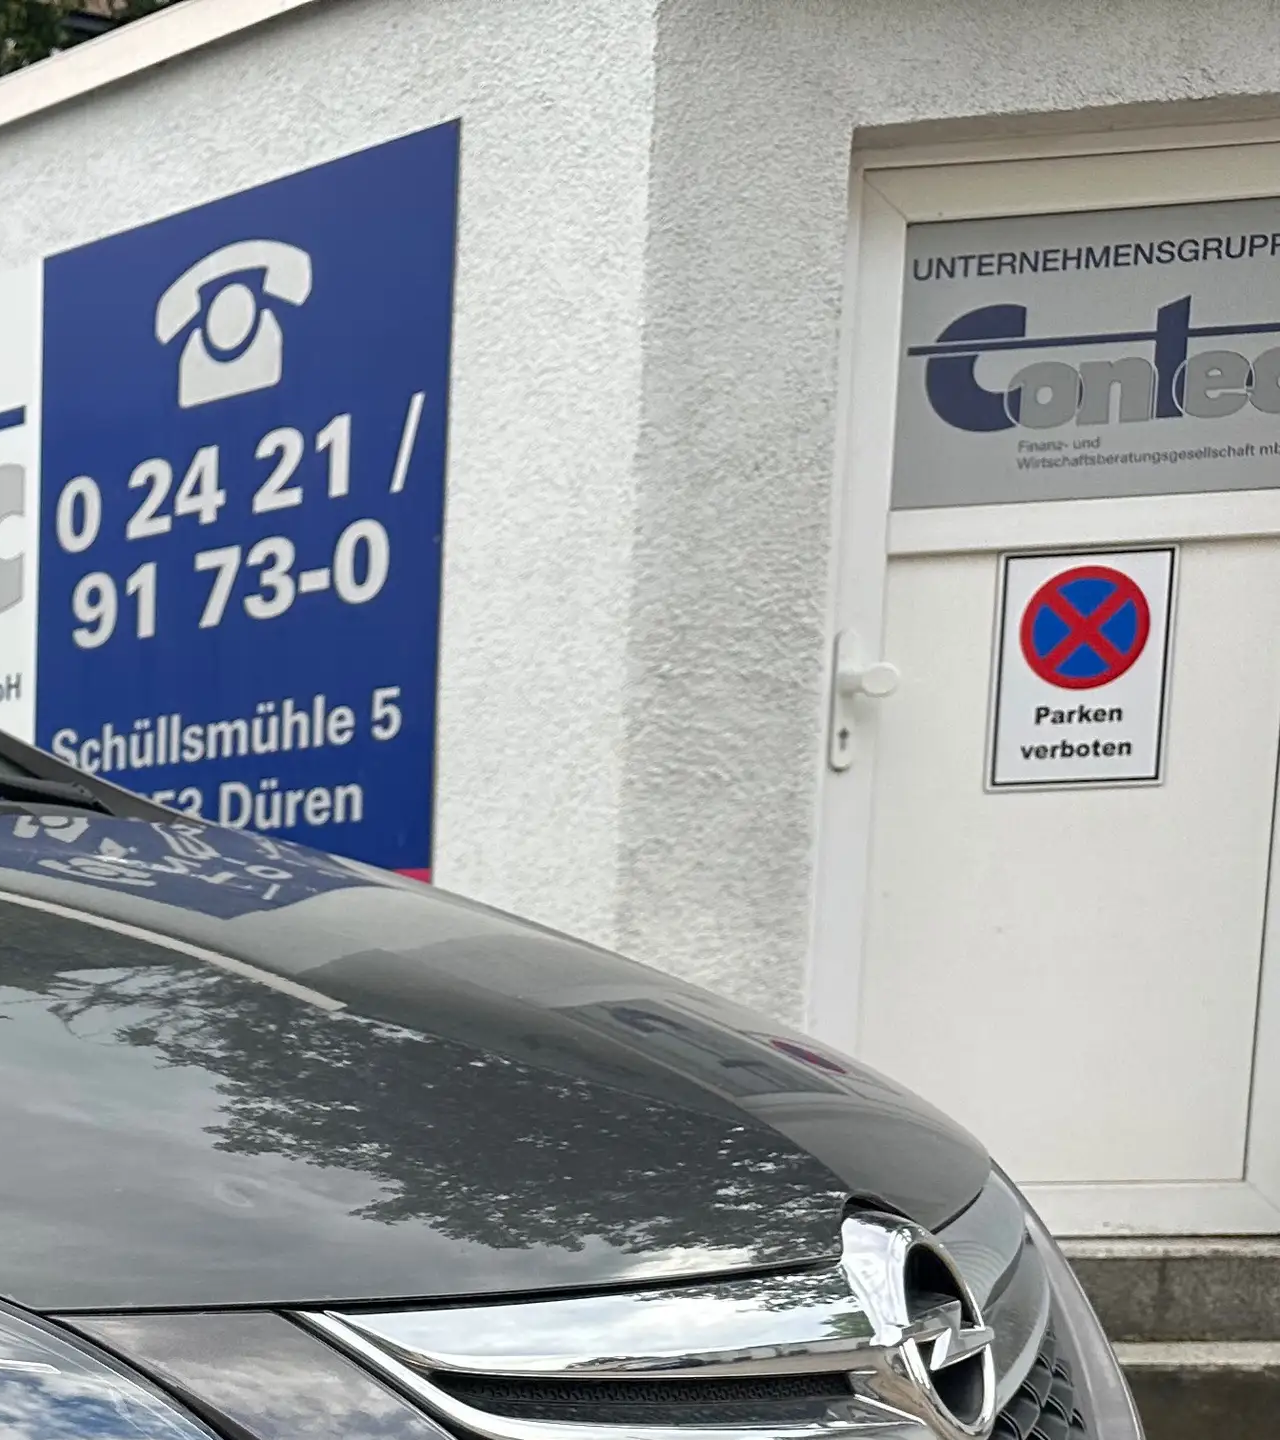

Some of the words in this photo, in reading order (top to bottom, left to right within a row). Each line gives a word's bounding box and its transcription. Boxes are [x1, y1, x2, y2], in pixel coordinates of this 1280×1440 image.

[1073, 437, 1101, 450] und
[56, 476, 102, 553] 0
[126, 444, 226, 541] 24
[252, 413, 351, 514] 21
[389, 391, 426, 493] /
[72, 562, 157, 649] 91
[194, 518, 390, 630] 73-0
[52, 694, 355, 774] Schüllsmühle
[371, 686, 402, 741] 5
[1034, 704, 1123, 725] Parken
[1020, 739, 1132, 760] verboten
[219, 778, 363, 830] Düren
